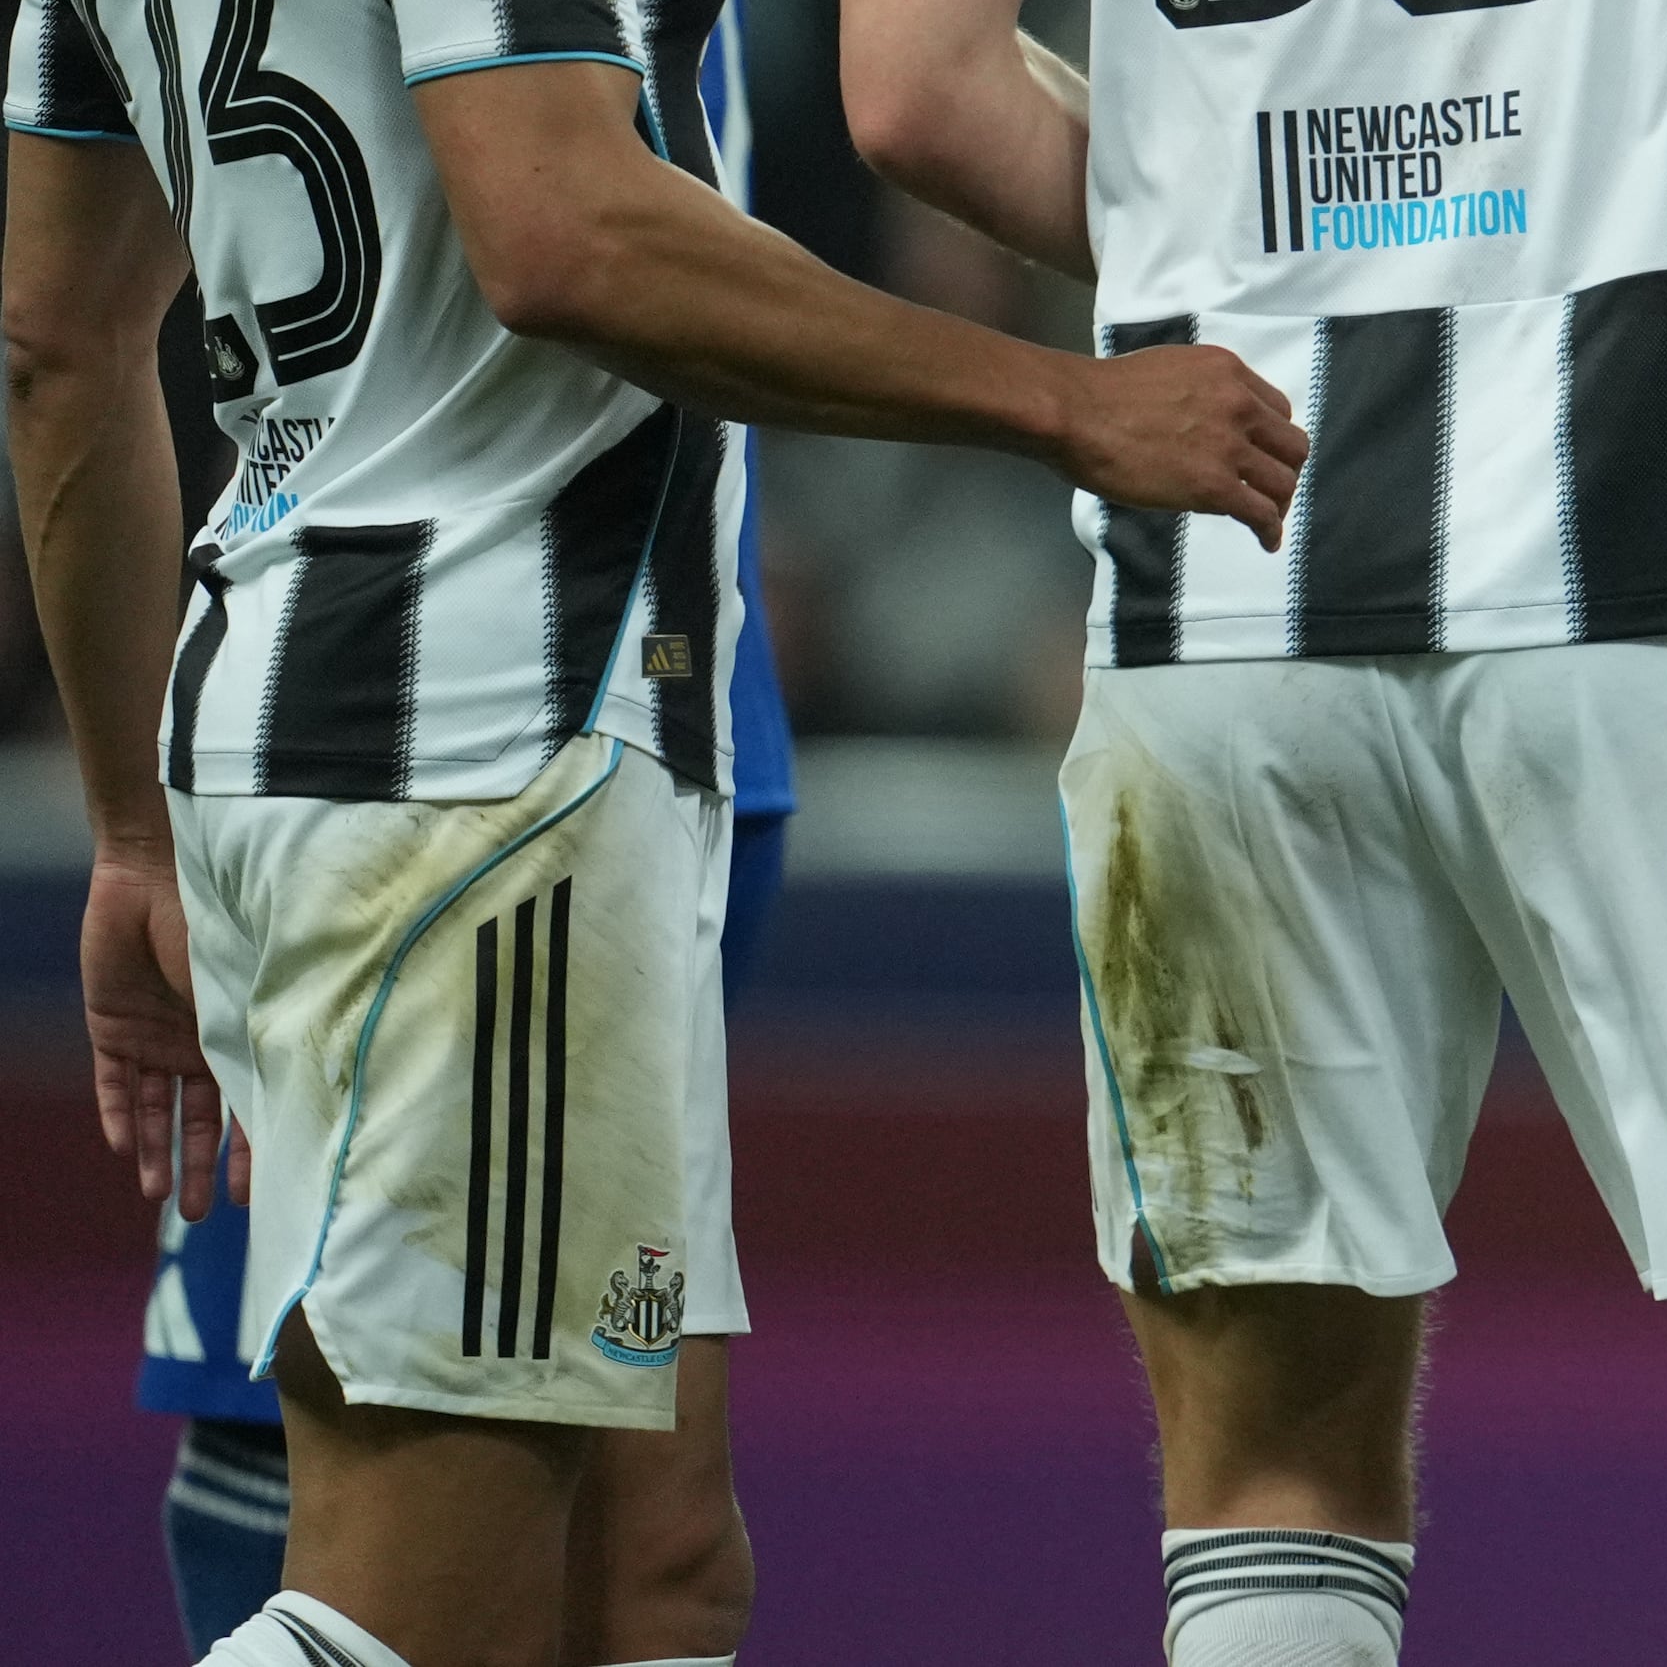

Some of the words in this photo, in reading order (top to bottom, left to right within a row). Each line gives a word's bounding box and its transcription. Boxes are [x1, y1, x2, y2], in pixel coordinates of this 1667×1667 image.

[1307, 89, 1523, 159] NEWCASTLE
[1308, 149, 1444, 206] UNITED
[1310, 188, 1527, 253] FOUNDATION
